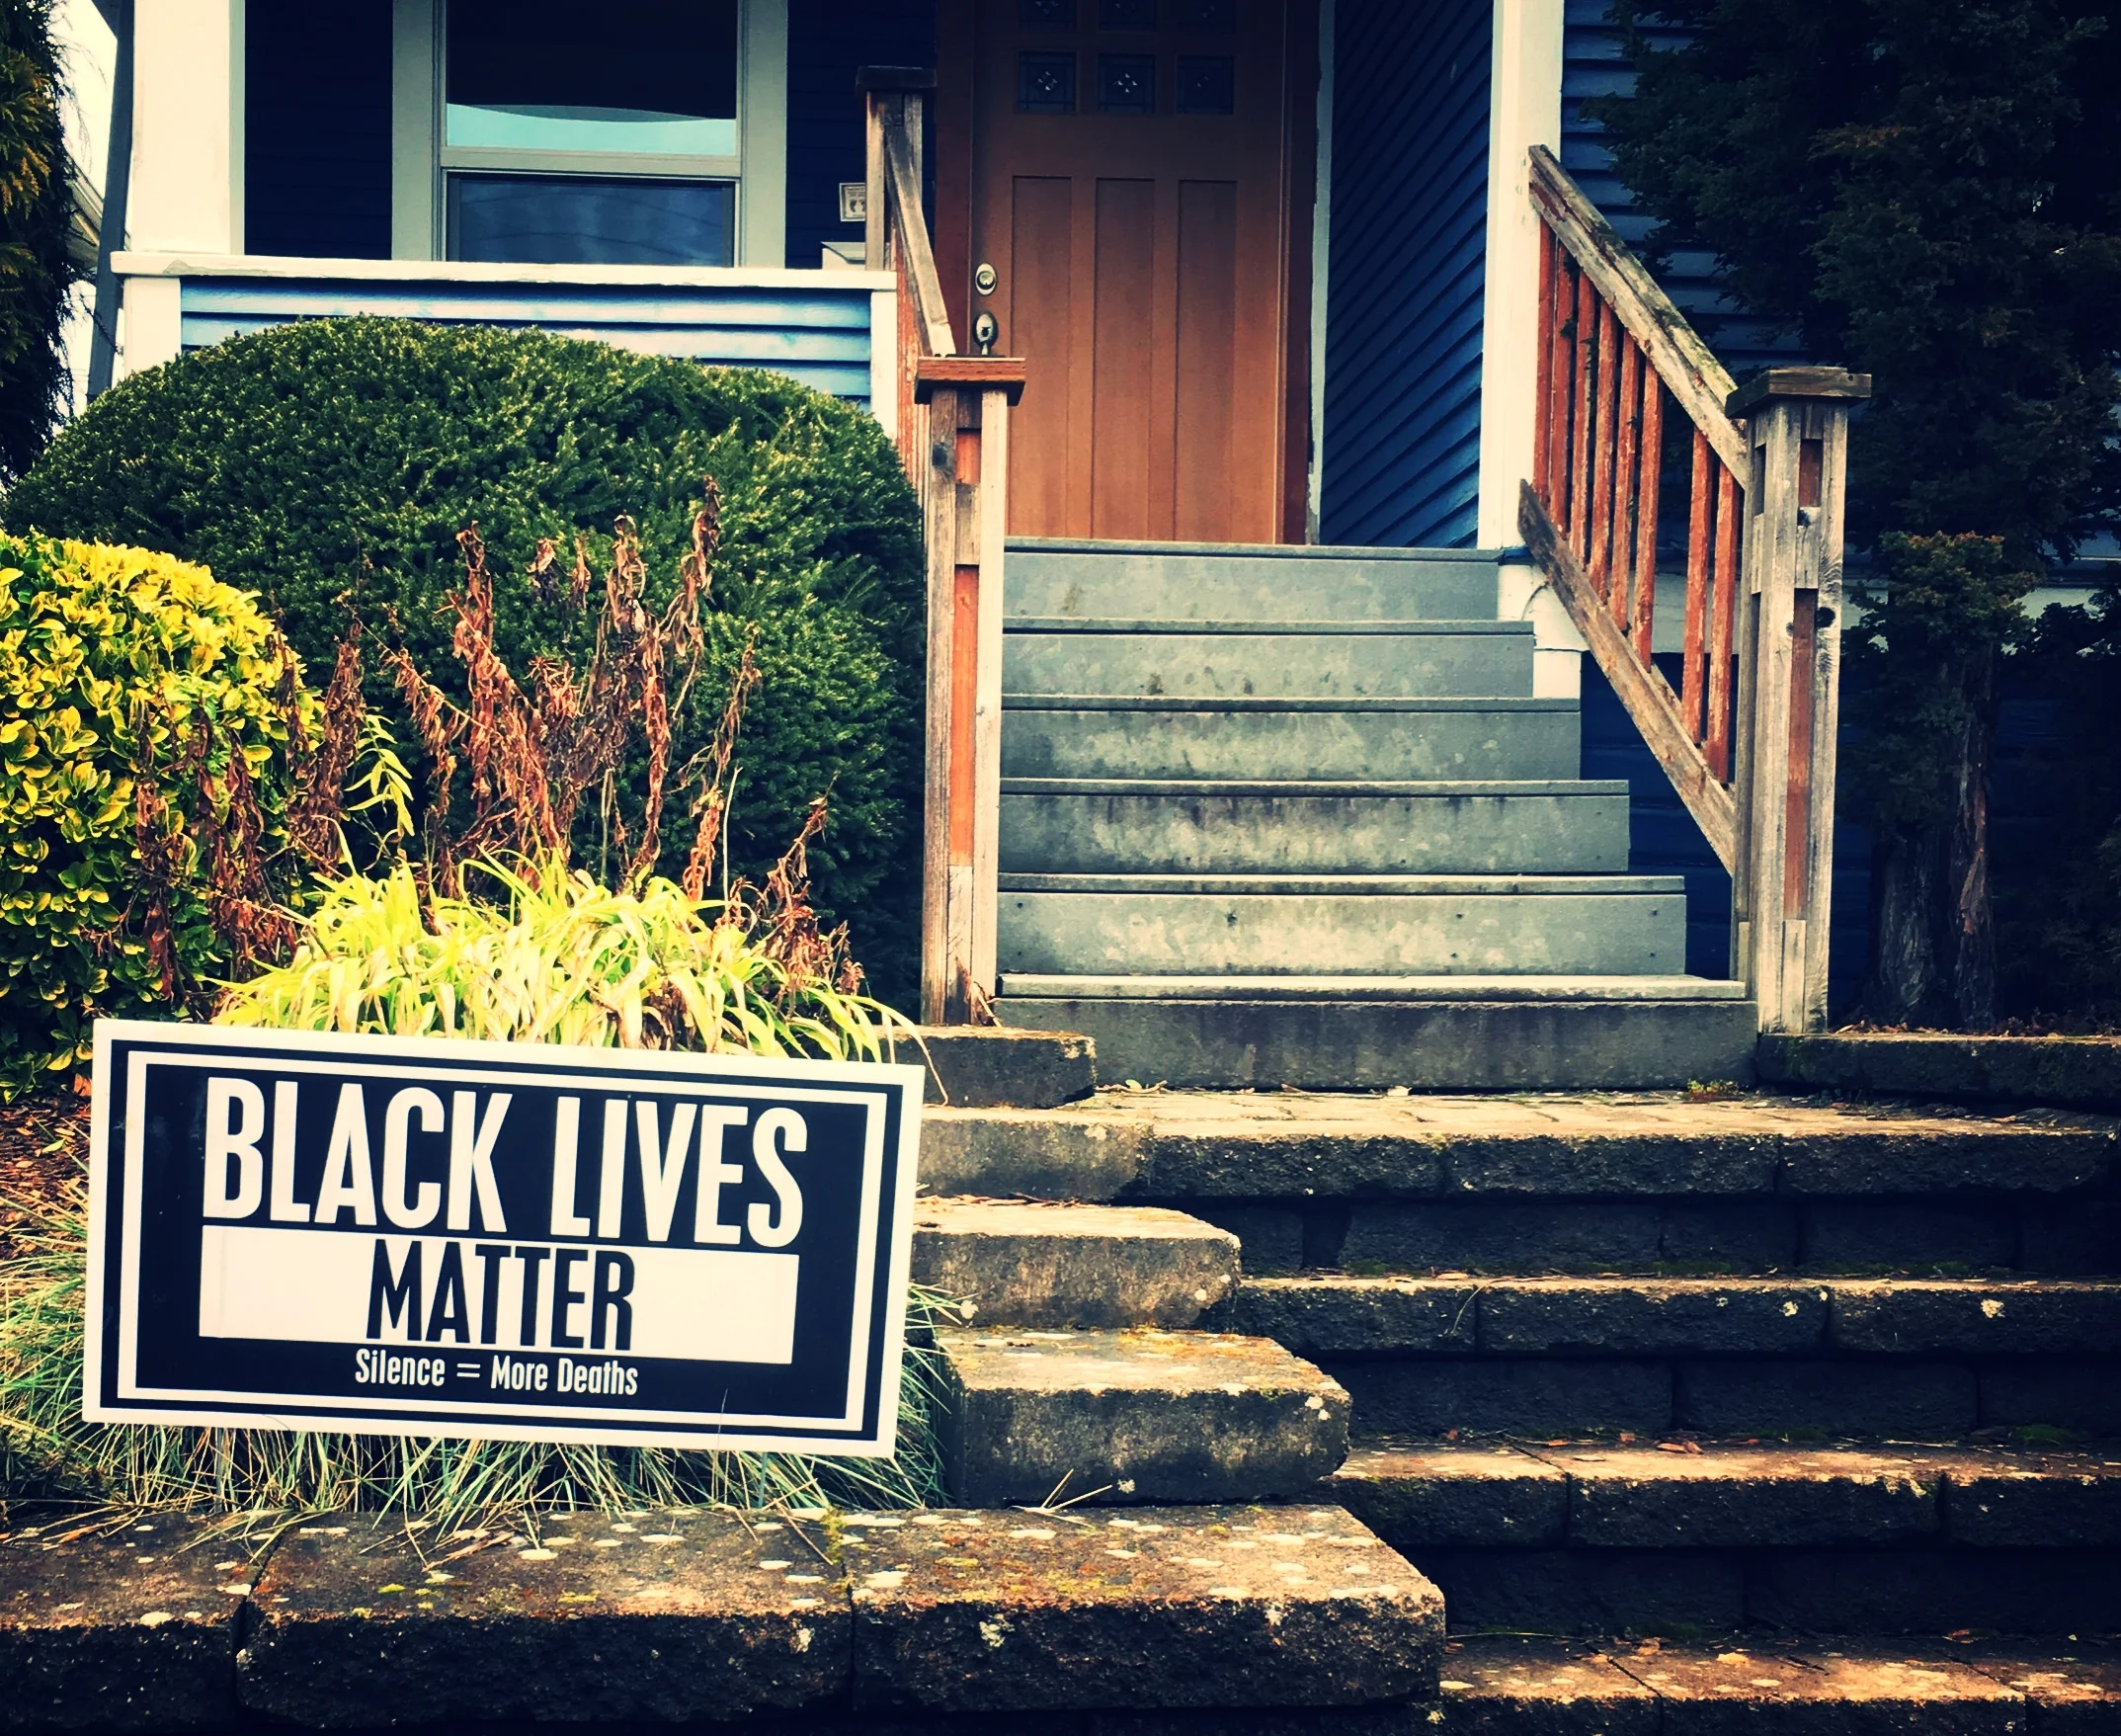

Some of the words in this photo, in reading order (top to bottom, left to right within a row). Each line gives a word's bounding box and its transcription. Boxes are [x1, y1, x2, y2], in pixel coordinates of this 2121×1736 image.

[203, 1076, 514, 1233] BLACK
[549, 1096, 808, 1248] LIVES
[366, 1238, 635, 1351] MATTER
[355, 1348, 446, 1387] Silence
[490, 1355, 548, 1391] More
[556, 1358, 638, 1396] Deaths
